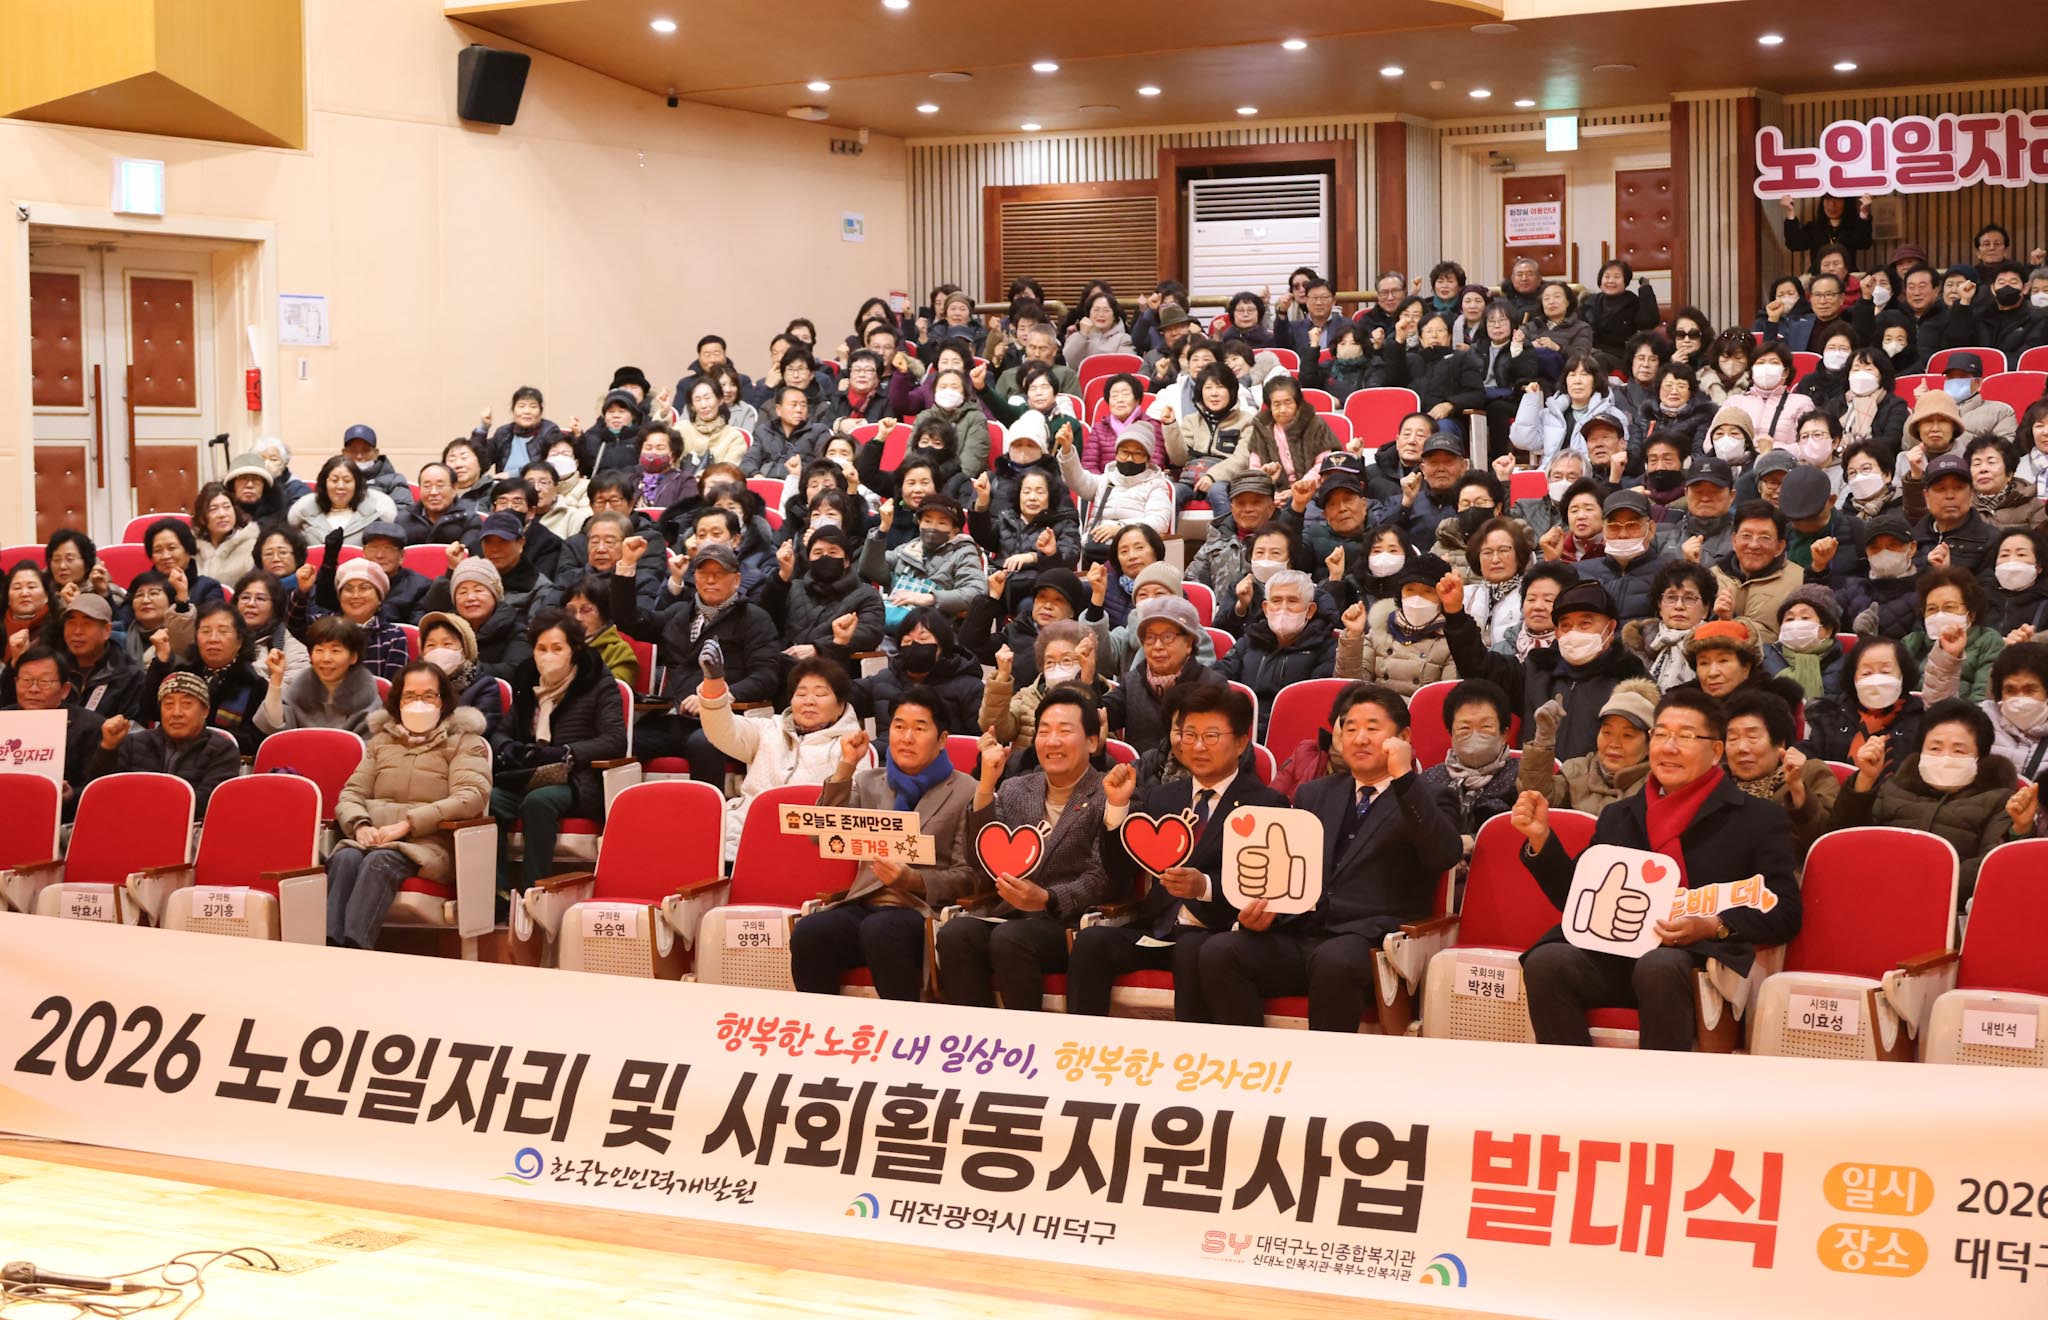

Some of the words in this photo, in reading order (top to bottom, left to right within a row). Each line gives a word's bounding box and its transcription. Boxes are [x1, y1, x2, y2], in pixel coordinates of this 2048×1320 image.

[13, 748, 54, 765] 일자리
[802, 812, 837, 829] 오늘도
[841, 814, 903, 832] 존재만으로
[850, 838, 889, 857] 즐거움
[77, 894, 98, 903] 구의원
[208, 893, 230, 903] 구의원
[1731, 877, 1761, 906] 더
[71, 904, 102, 919] 박효서
[598, 911, 620, 920] 구의원
[593, 923, 625, 937] 유승연
[742, 920, 765, 930] 구의원
[737, 932, 771, 947] 양영자
[1470, 966, 1505, 981] 국회의원
[1468, 980, 1505, 999] 박정현
[1810, 999, 1839, 1012] 시의원
[1803, 1013, 1843, 1032] 이효성
[1982, 1022, 2017, 1038] 내빈석
[716, 1012, 814, 1057] 행복한
[815, 1024, 888, 1064] 노후!
[892, 1034, 931, 1065] 내
[940, 1035, 1038, 1080] 일상이,
[1054, 1041, 1164, 1087] 행복한
[1173, 1053, 1292, 1094] 일자리!
[14, 995, 206, 1094] 2026
[215, 1018, 591, 1142] 노인일자리
[602, 1059, 691, 1155] 및
[701, 1069, 1430, 1233] 사회활동지원사업
[1467, 1130, 1784, 1269] 발대식
[550, 1156, 757, 1204] 한국노인인력개발원
[1842, 1167, 1917, 1212] 일시
[890, 1199, 1026, 1236] 대전광역시
[1033, 1215, 1117, 1245] 대덕구
[1201, 1230, 1253, 1255] SY
[1256, 1235, 1416, 1268] 대덕구노인종합복지관
[1834, 1227, 1910, 1270] 장소
